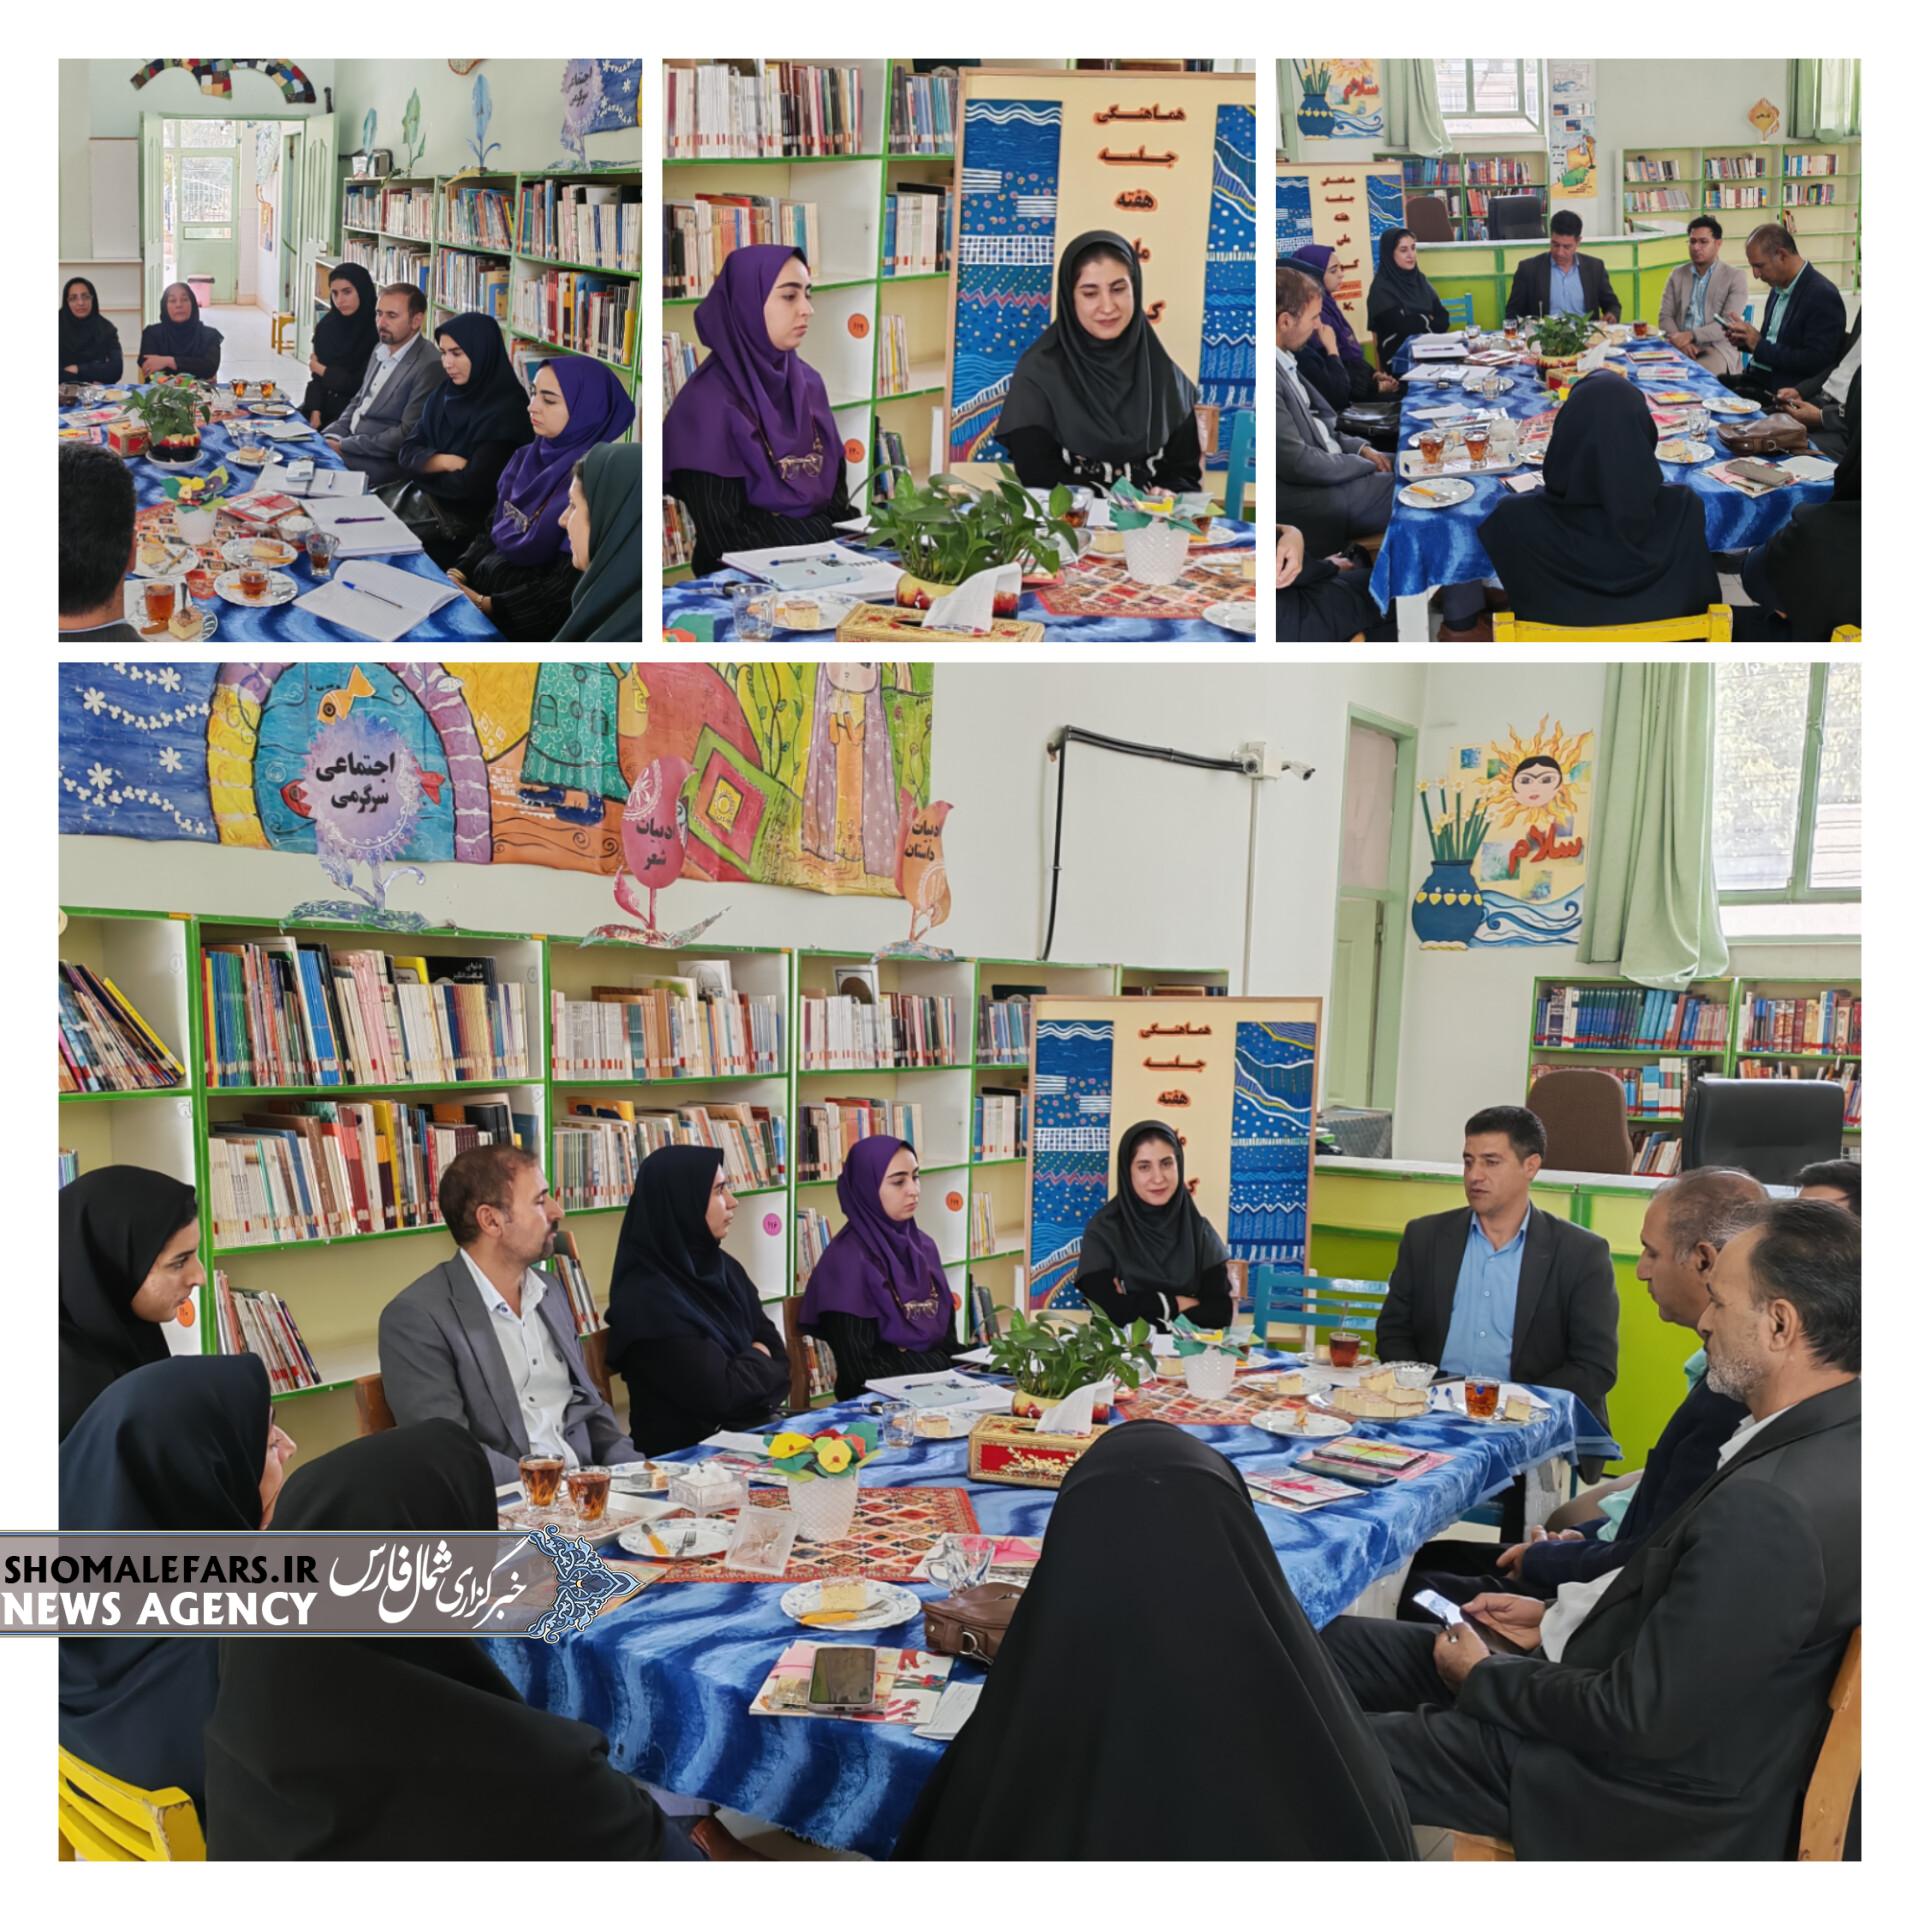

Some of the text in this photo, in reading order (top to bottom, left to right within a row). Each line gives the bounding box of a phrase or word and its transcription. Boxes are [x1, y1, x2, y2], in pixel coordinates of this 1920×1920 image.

[1093, 103, 1187, 125] هماهنگی
[1098, 145, 1179, 169] جلسه
[1114, 189, 1158, 212] هفته
[1134, 238, 1151, 263] مل
[315, 751, 396, 783] اجتماعی
[330, 783, 389, 813] سرگرمی
[636, 817, 674, 844] دبیات
[911, 819, 941, 844] دبیات
[643, 849, 667, 871] شعر
[904, 842, 935, 862] داستان
[1508, 822, 1583, 878] سلام
[1138, 1022, 1213, 1040] هماهنگی
[1142, 1054, 1207, 1074] جلسه
[1157, 1089, 1191, 1107] هفته
